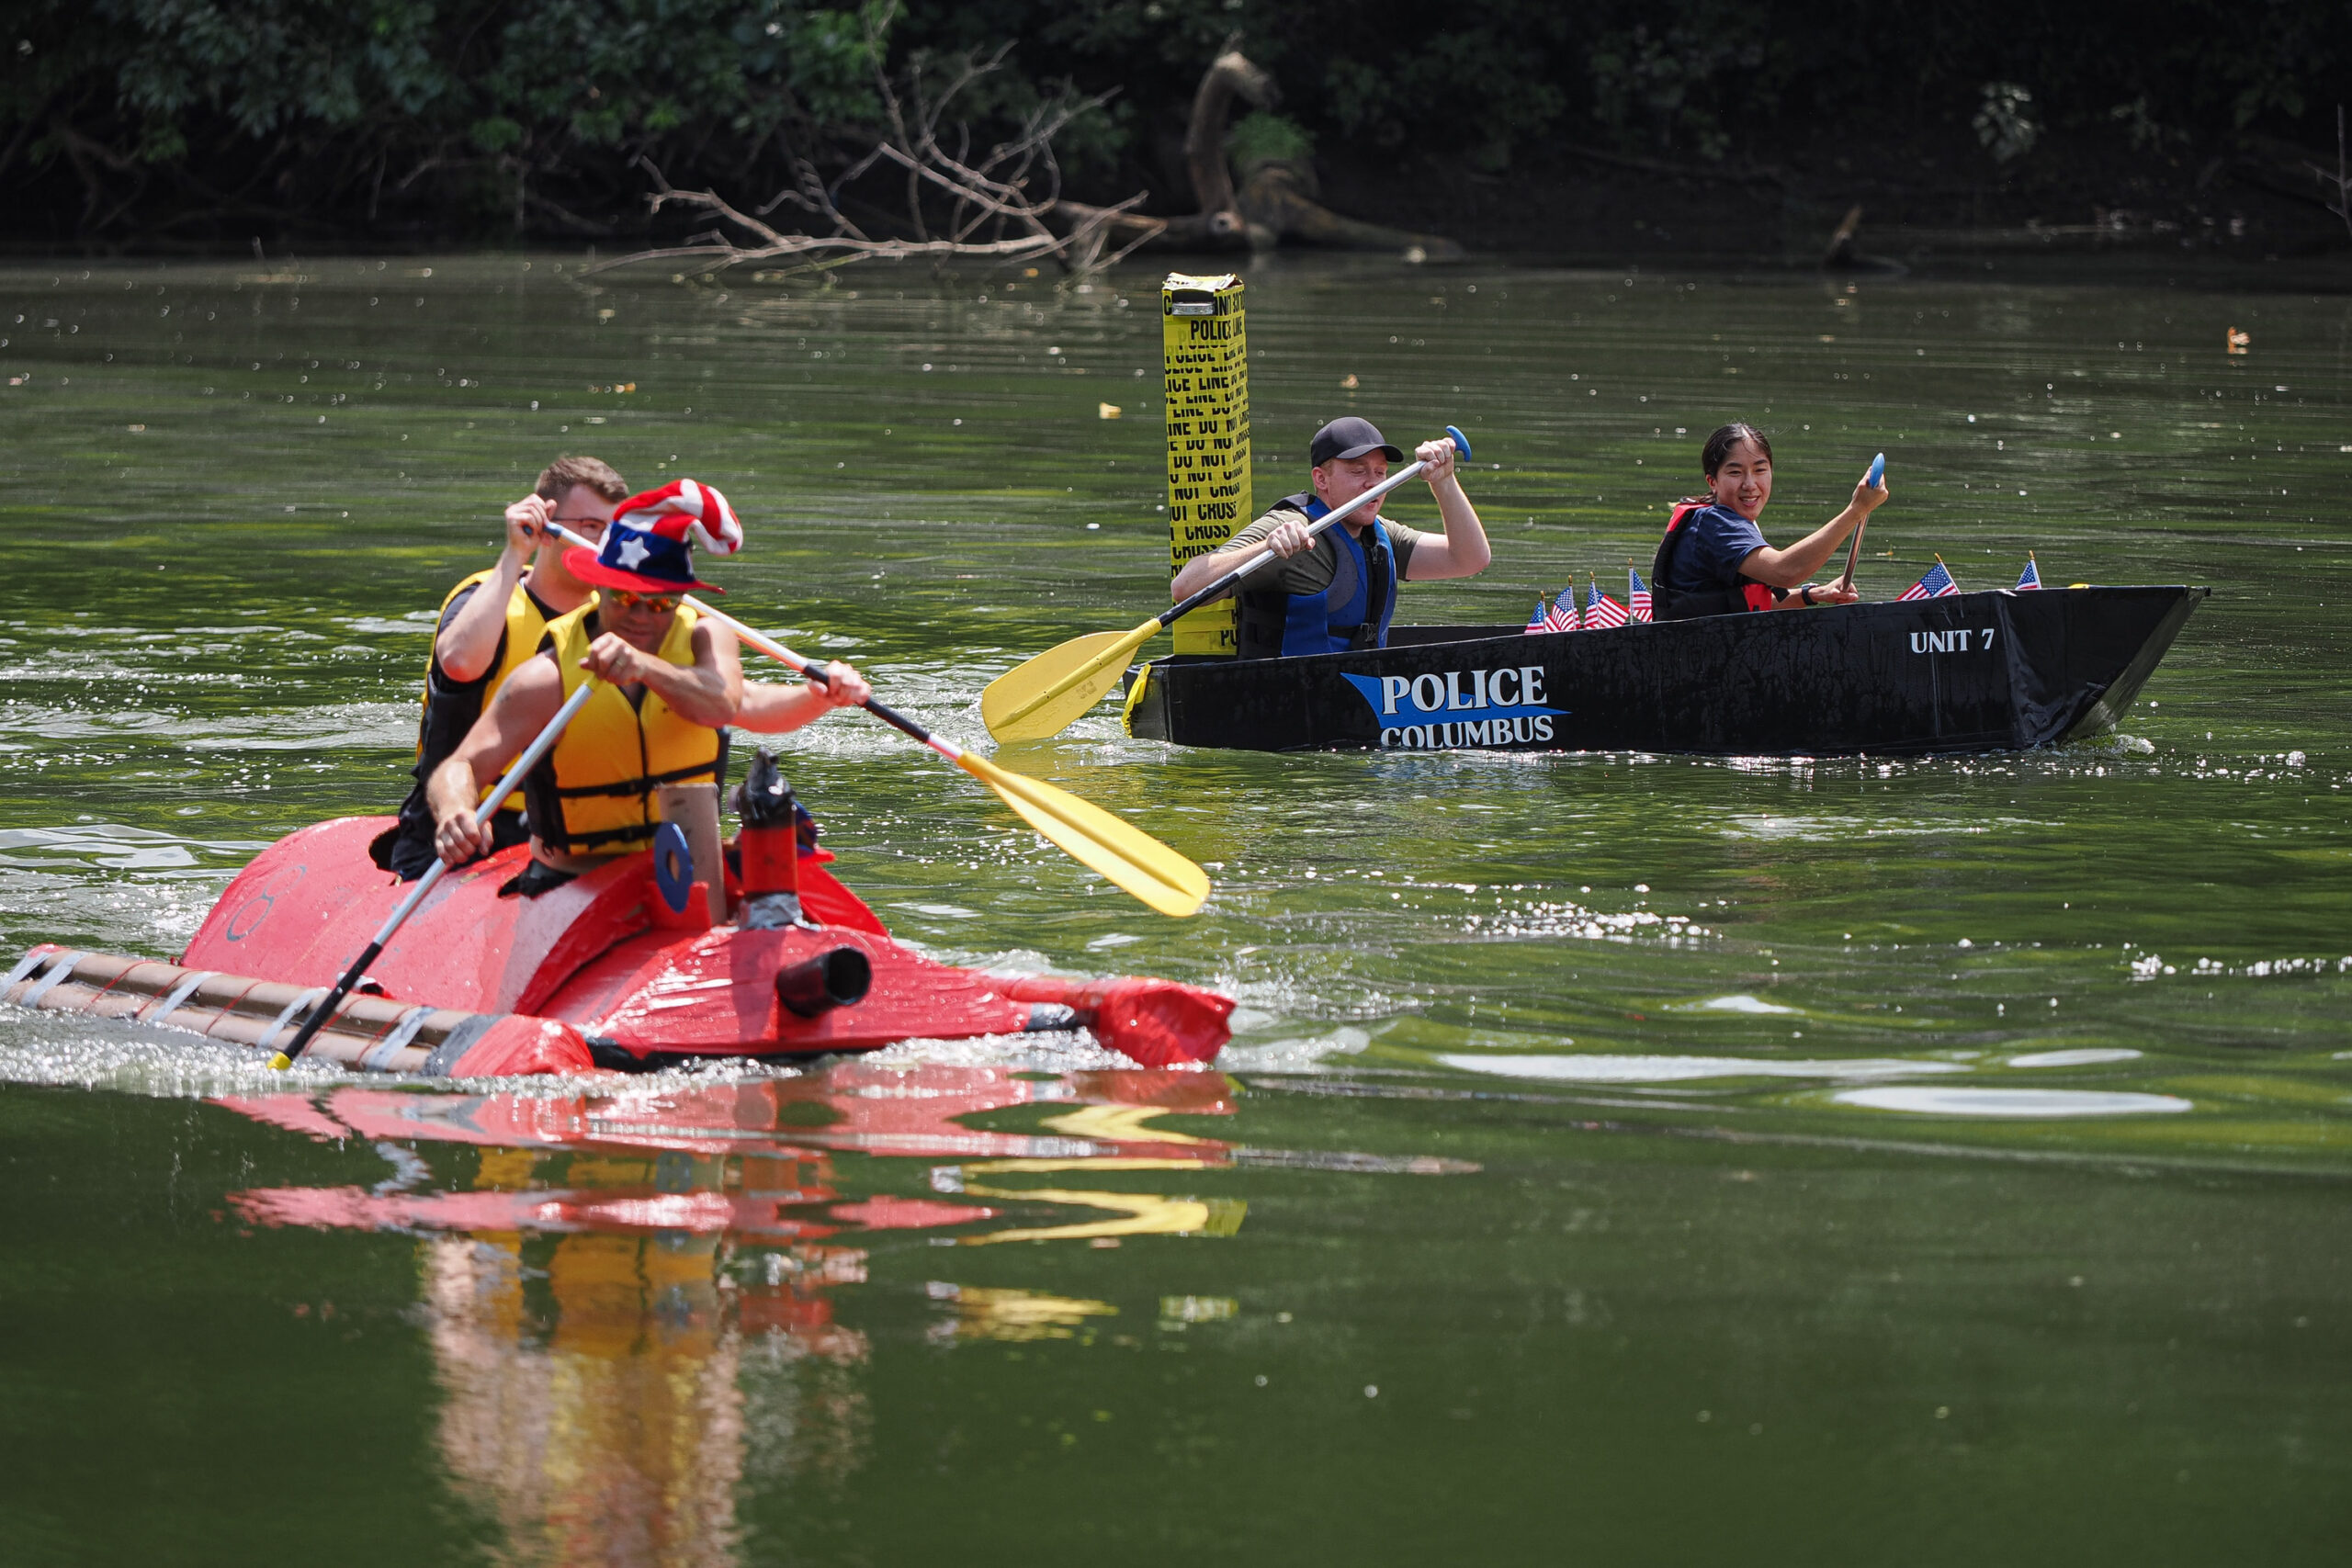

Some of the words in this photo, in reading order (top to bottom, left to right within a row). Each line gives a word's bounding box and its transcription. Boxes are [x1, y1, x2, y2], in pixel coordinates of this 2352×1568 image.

[1191, 320, 1231, 340] POLICE
[1909, 629, 1973, 654] UNIT
[1981, 628, 1995, 650] 7
[1380, 665, 1549, 716] POLICE
[1380, 715, 1555, 749] COLUMBUS
